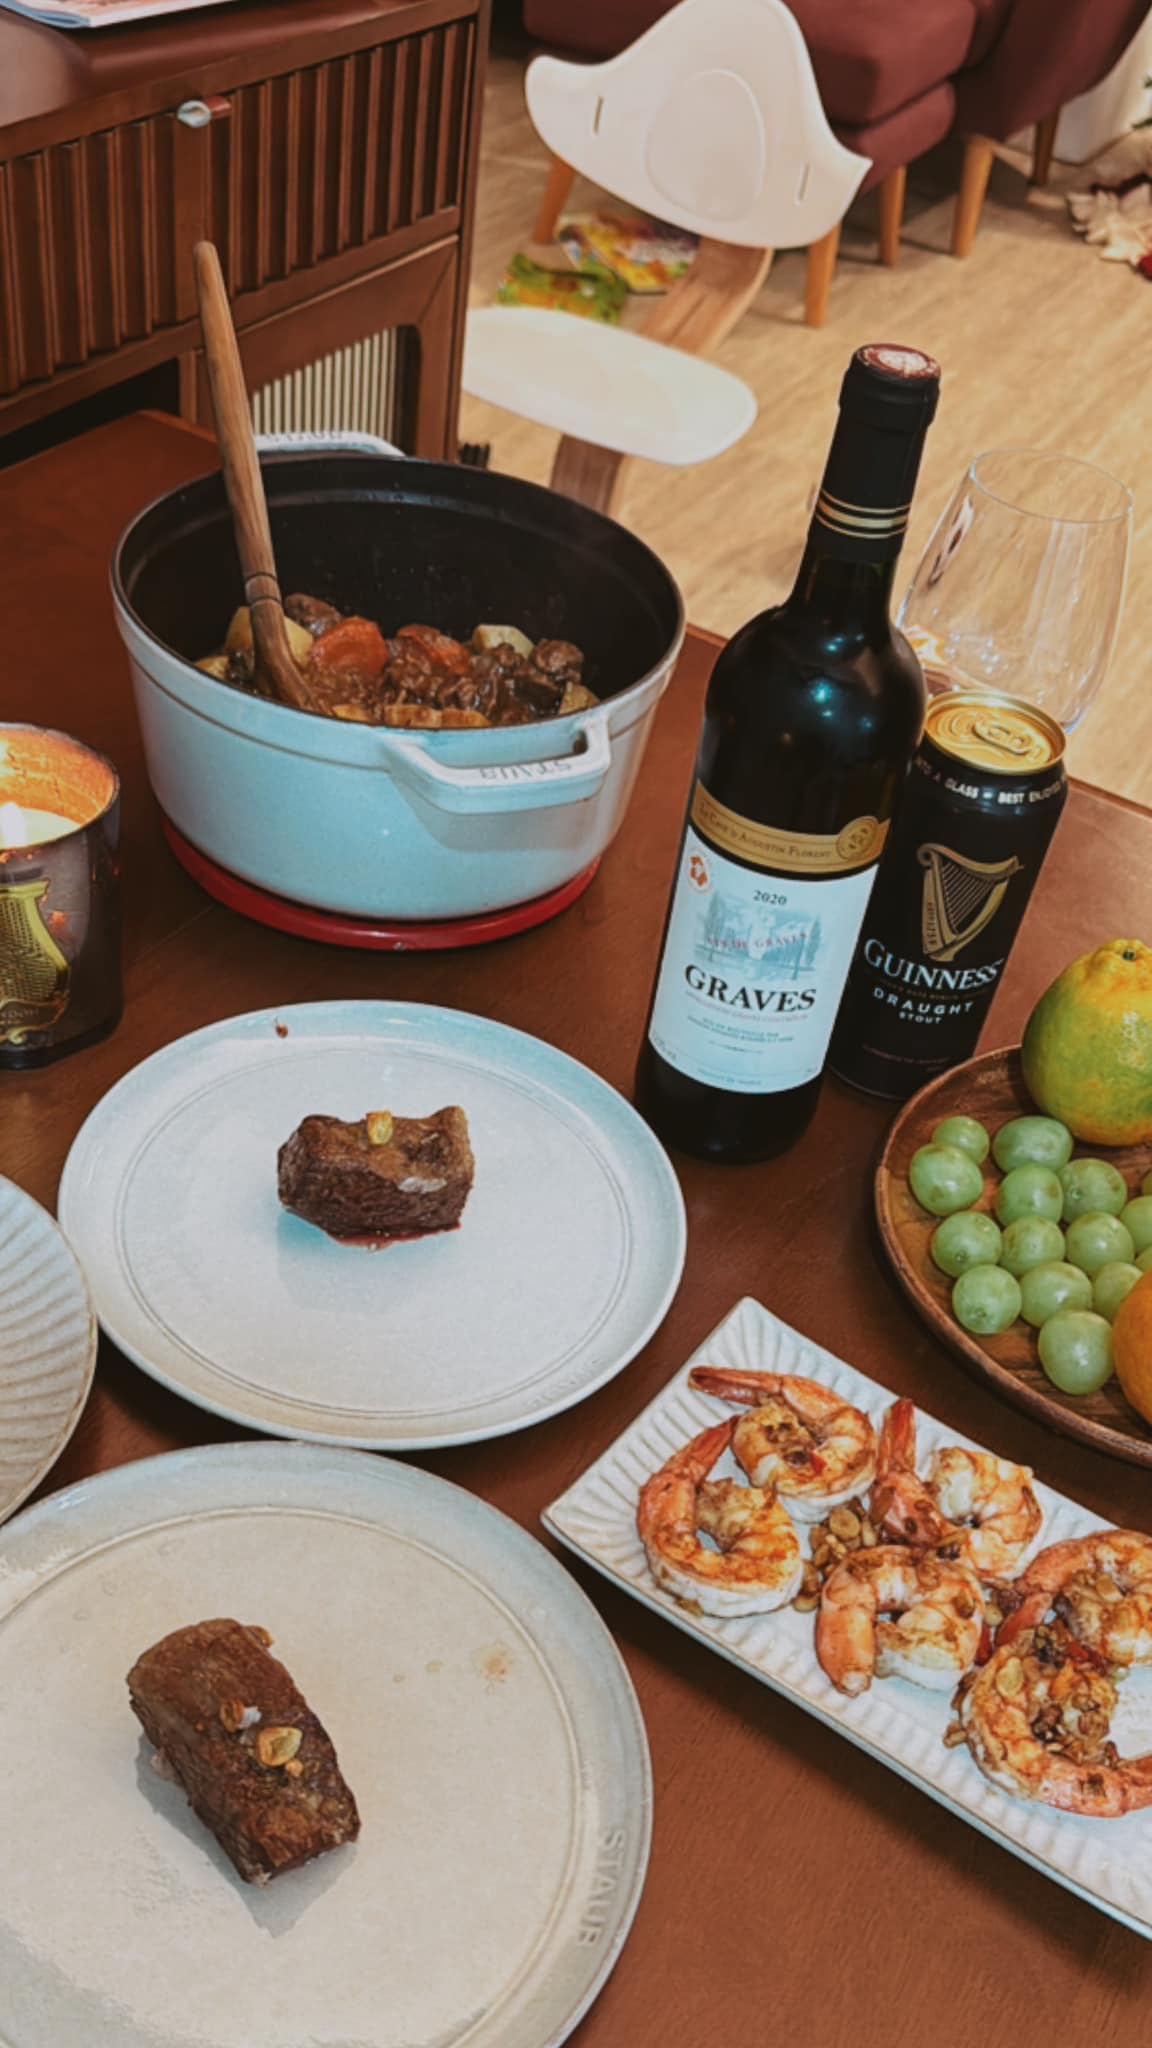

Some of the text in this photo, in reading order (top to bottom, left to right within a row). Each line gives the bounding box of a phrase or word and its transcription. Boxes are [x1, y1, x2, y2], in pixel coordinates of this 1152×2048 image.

[944, 777, 979, 799] GLASS
[998, 792, 1025, 804] BEST
[753, 889, 788, 905] 2020
[864, 938, 999, 990] GUINNESS
[685, 964, 817, 1013] GRAVES
[873, 987, 974, 1015] DRAUGHT
[899, 1012, 943, 1024] STOUT
